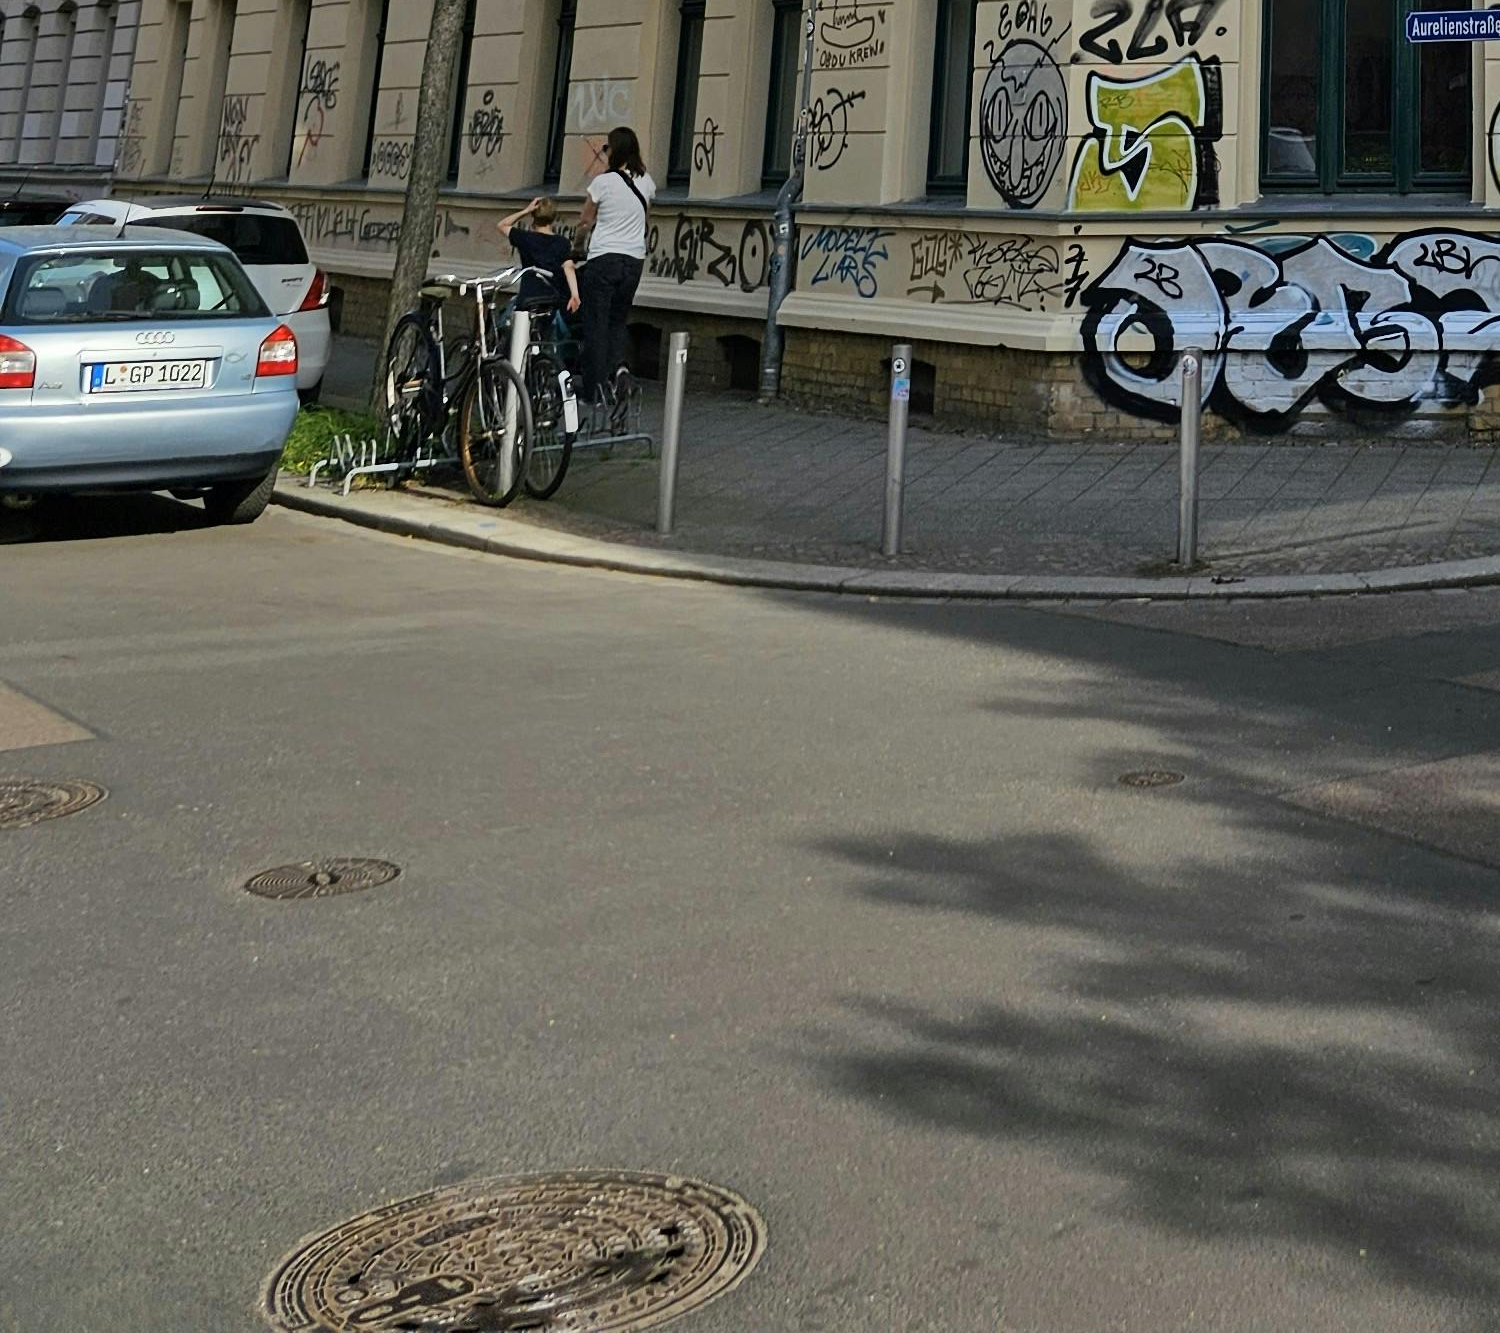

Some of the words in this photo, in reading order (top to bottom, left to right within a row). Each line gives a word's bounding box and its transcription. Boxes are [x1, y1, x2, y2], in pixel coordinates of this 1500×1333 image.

[1412, 16, 1500, 37] Aurelienstraße
[104, 367, 116, 384] L
[130, 365, 153, 383] GP
[158, 363, 202, 382] 1022
